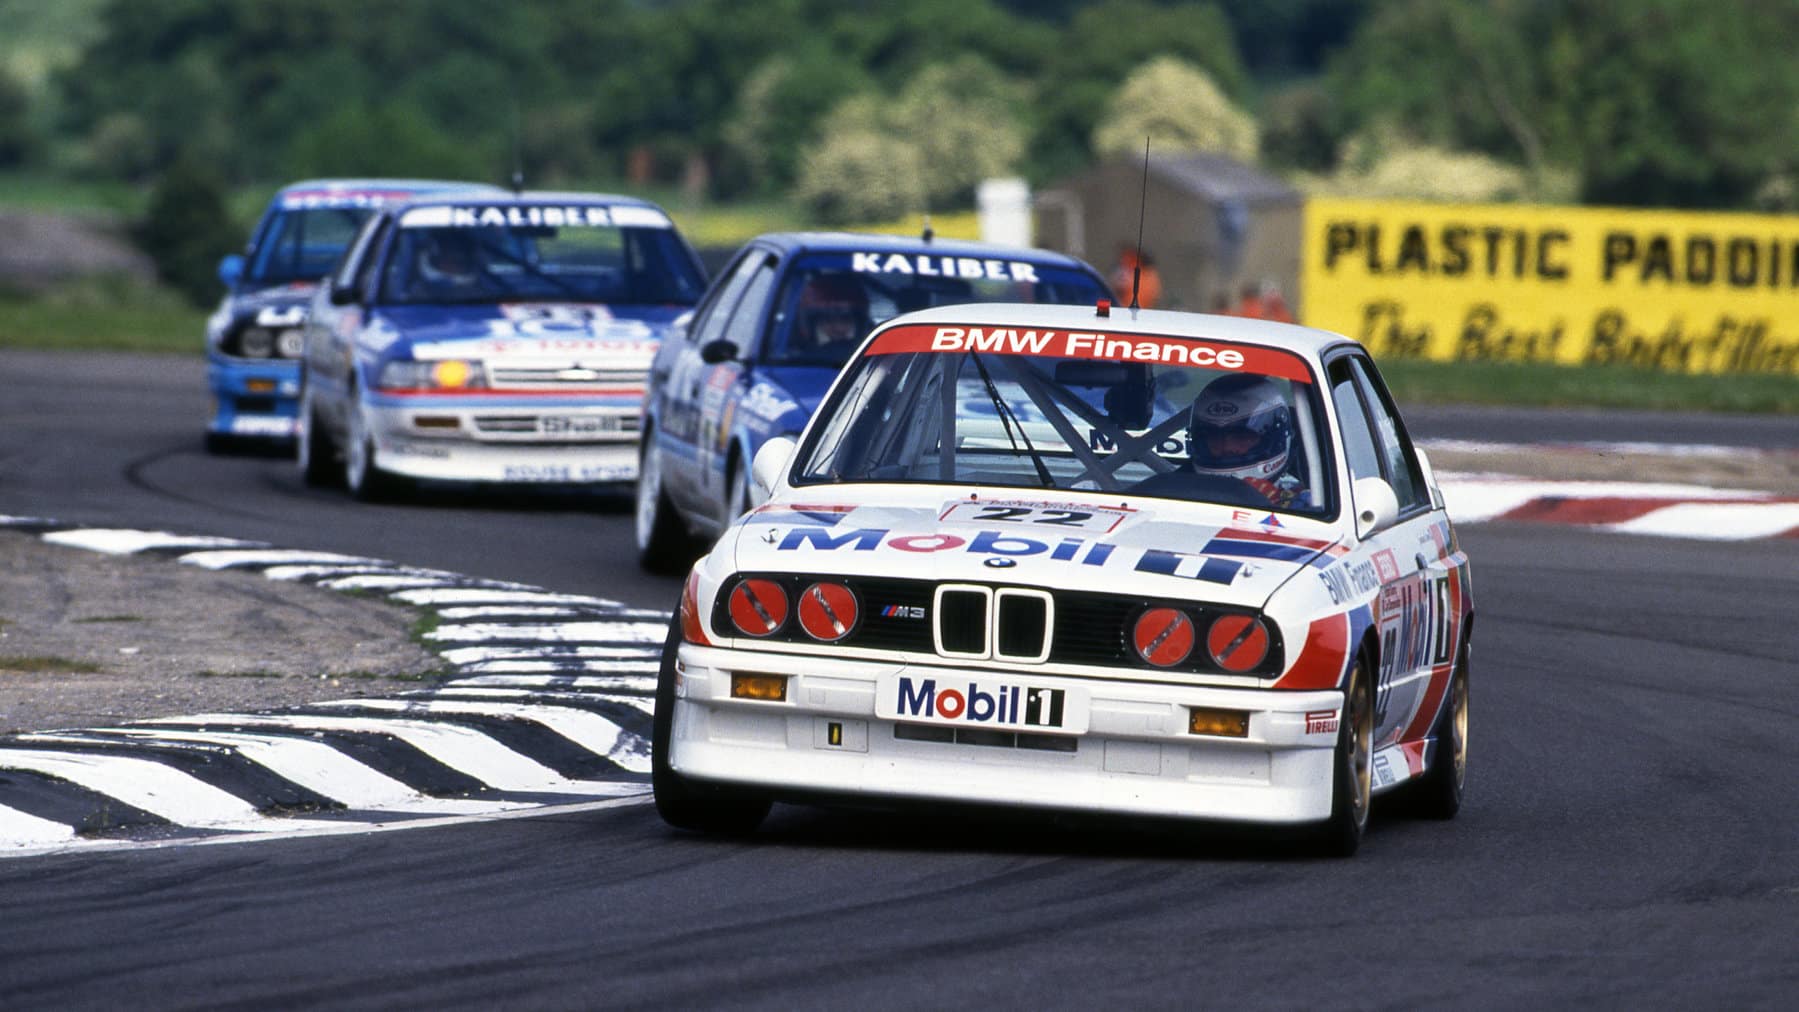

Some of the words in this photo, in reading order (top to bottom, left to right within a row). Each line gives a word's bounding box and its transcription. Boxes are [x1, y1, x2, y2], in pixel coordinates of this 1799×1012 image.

[453, 206, 612, 227] KALIBER
[851, 252, 1040, 284] KALIBER
[1324, 220, 1572, 281] PLASTIC
[1602, 231, 1799, 288] PADDI
[931, 327, 1056, 352] BMW
[1065, 333, 1245, 369] Finance
[1452, 301, 1570, 363] Best
[972, 506, 1093, 527] 22
[777, 528, 1117, 566] Mobil
[1318, 566, 1353, 606] BMW
[894, 605, 925, 618] M3
[896, 677, 1020, 724] Mobil
[1305, 709, 1338, 735] PIRELLI
